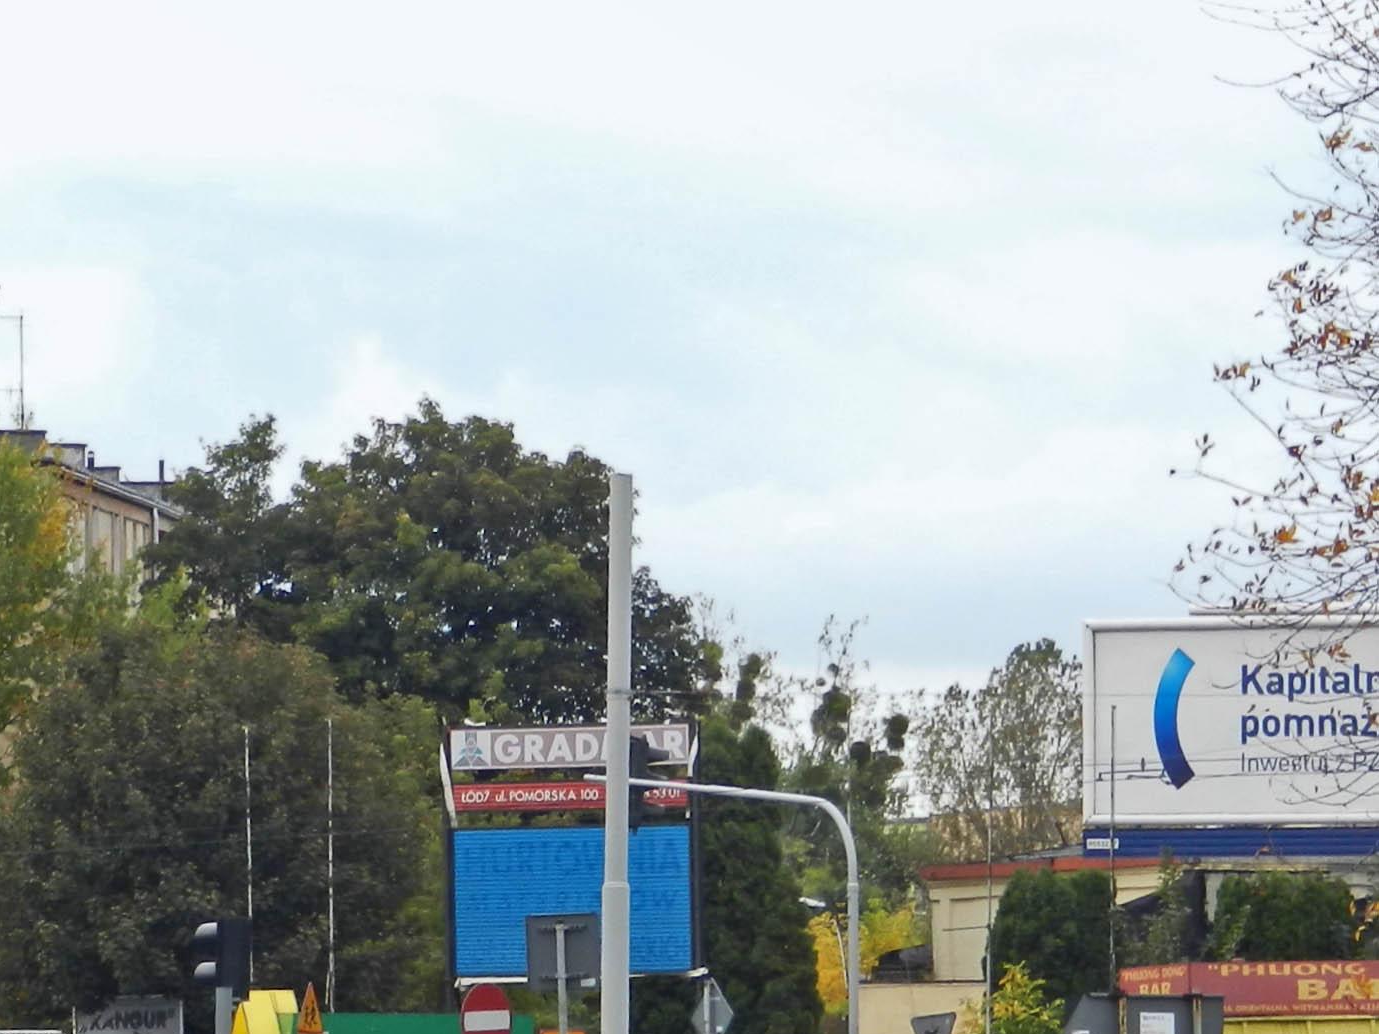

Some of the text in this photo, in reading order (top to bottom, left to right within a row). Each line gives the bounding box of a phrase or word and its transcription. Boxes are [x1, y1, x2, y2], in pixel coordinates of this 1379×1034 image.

[494, 730, 685, 762] GRADR
[509, 788, 576, 802] POMORSKA
[1140, 982, 1171, 996] BAR
